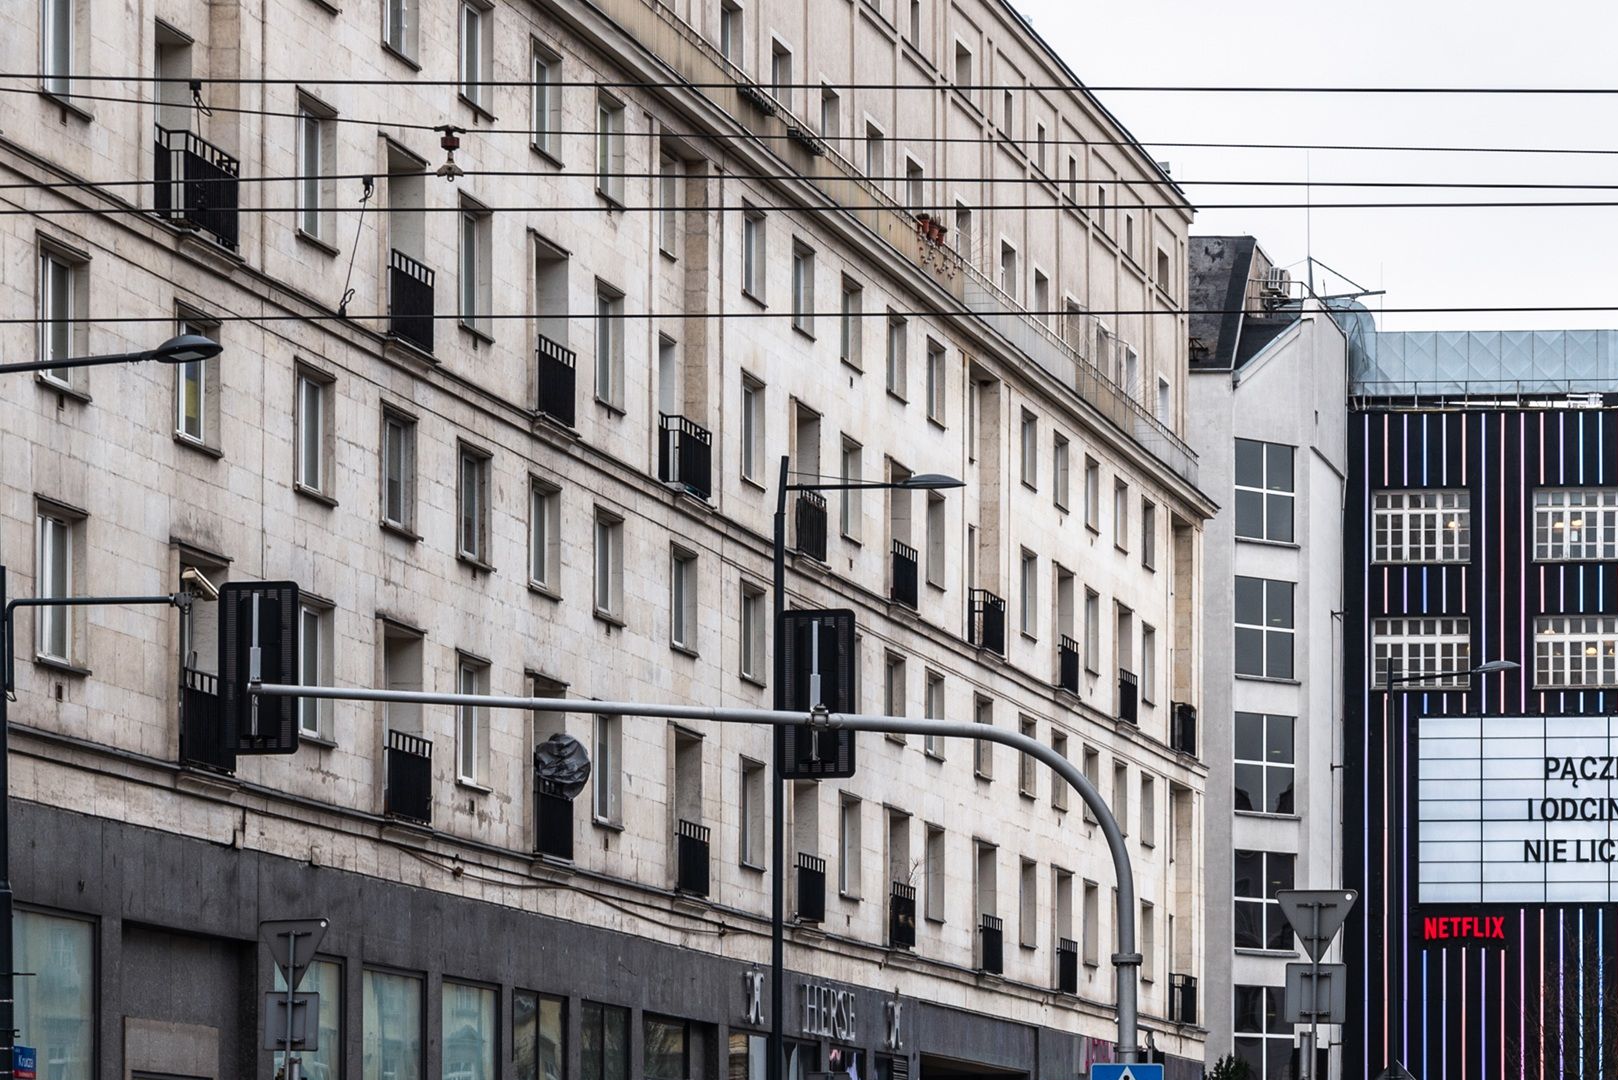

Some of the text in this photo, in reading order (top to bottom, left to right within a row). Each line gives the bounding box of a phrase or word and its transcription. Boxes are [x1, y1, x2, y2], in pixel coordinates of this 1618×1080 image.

[1528, 798, 1533, 821] I
[1524, 839, 1567, 862] NIE
[1424, 916, 1504, 940] NETFLIX
[802, 984, 856, 1042] HERSE
